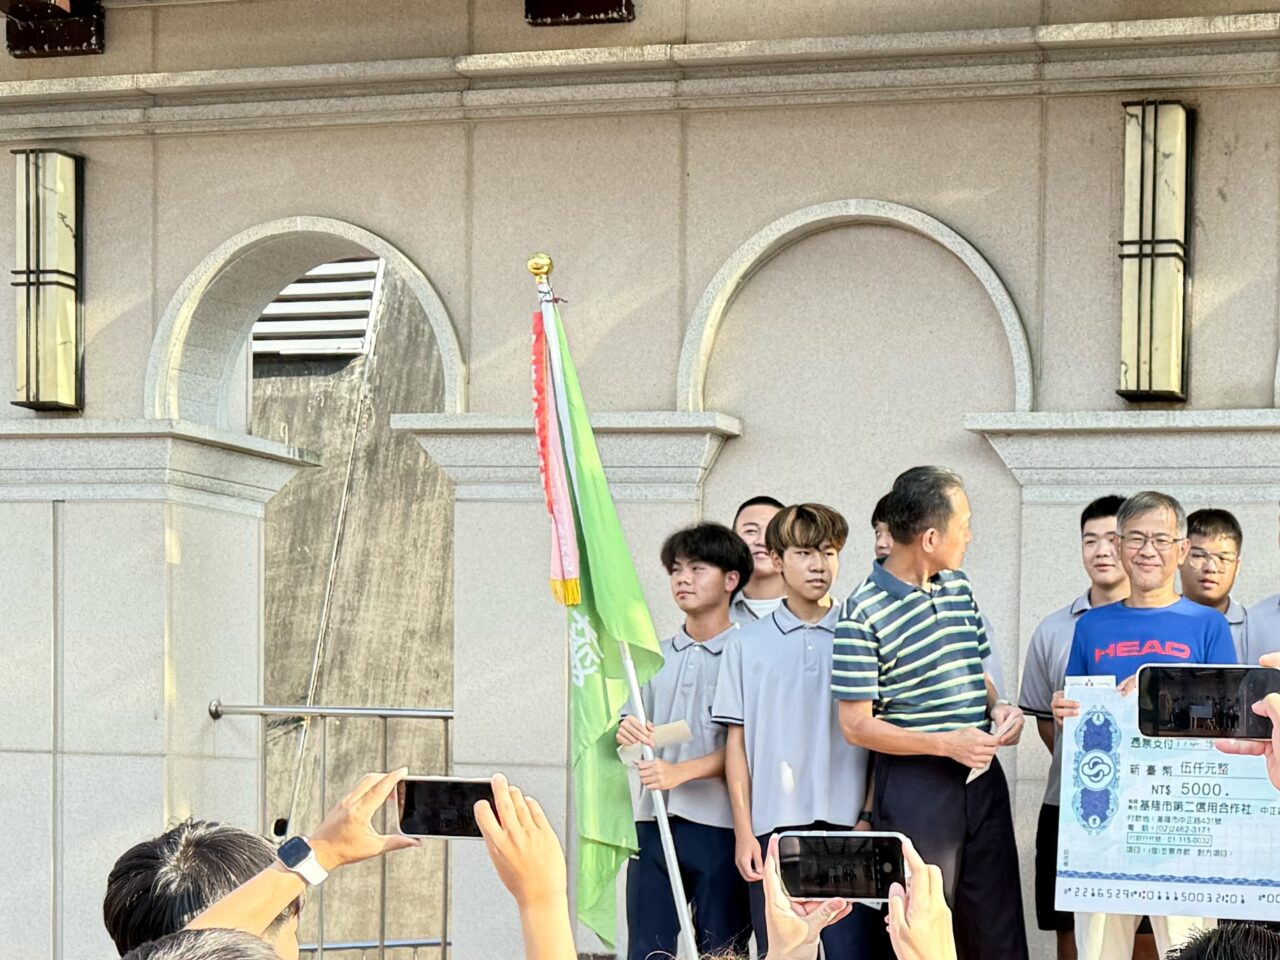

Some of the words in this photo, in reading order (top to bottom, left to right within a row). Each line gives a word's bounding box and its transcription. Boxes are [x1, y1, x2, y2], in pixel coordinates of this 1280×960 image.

[1094, 640, 1191, 662] HEAD
[1181, 761, 1229, 775] 伍仟元整
[1151, 784, 1171, 795] NT$
[1140, 799, 1251, 815] 基隆市第二信用合作社
